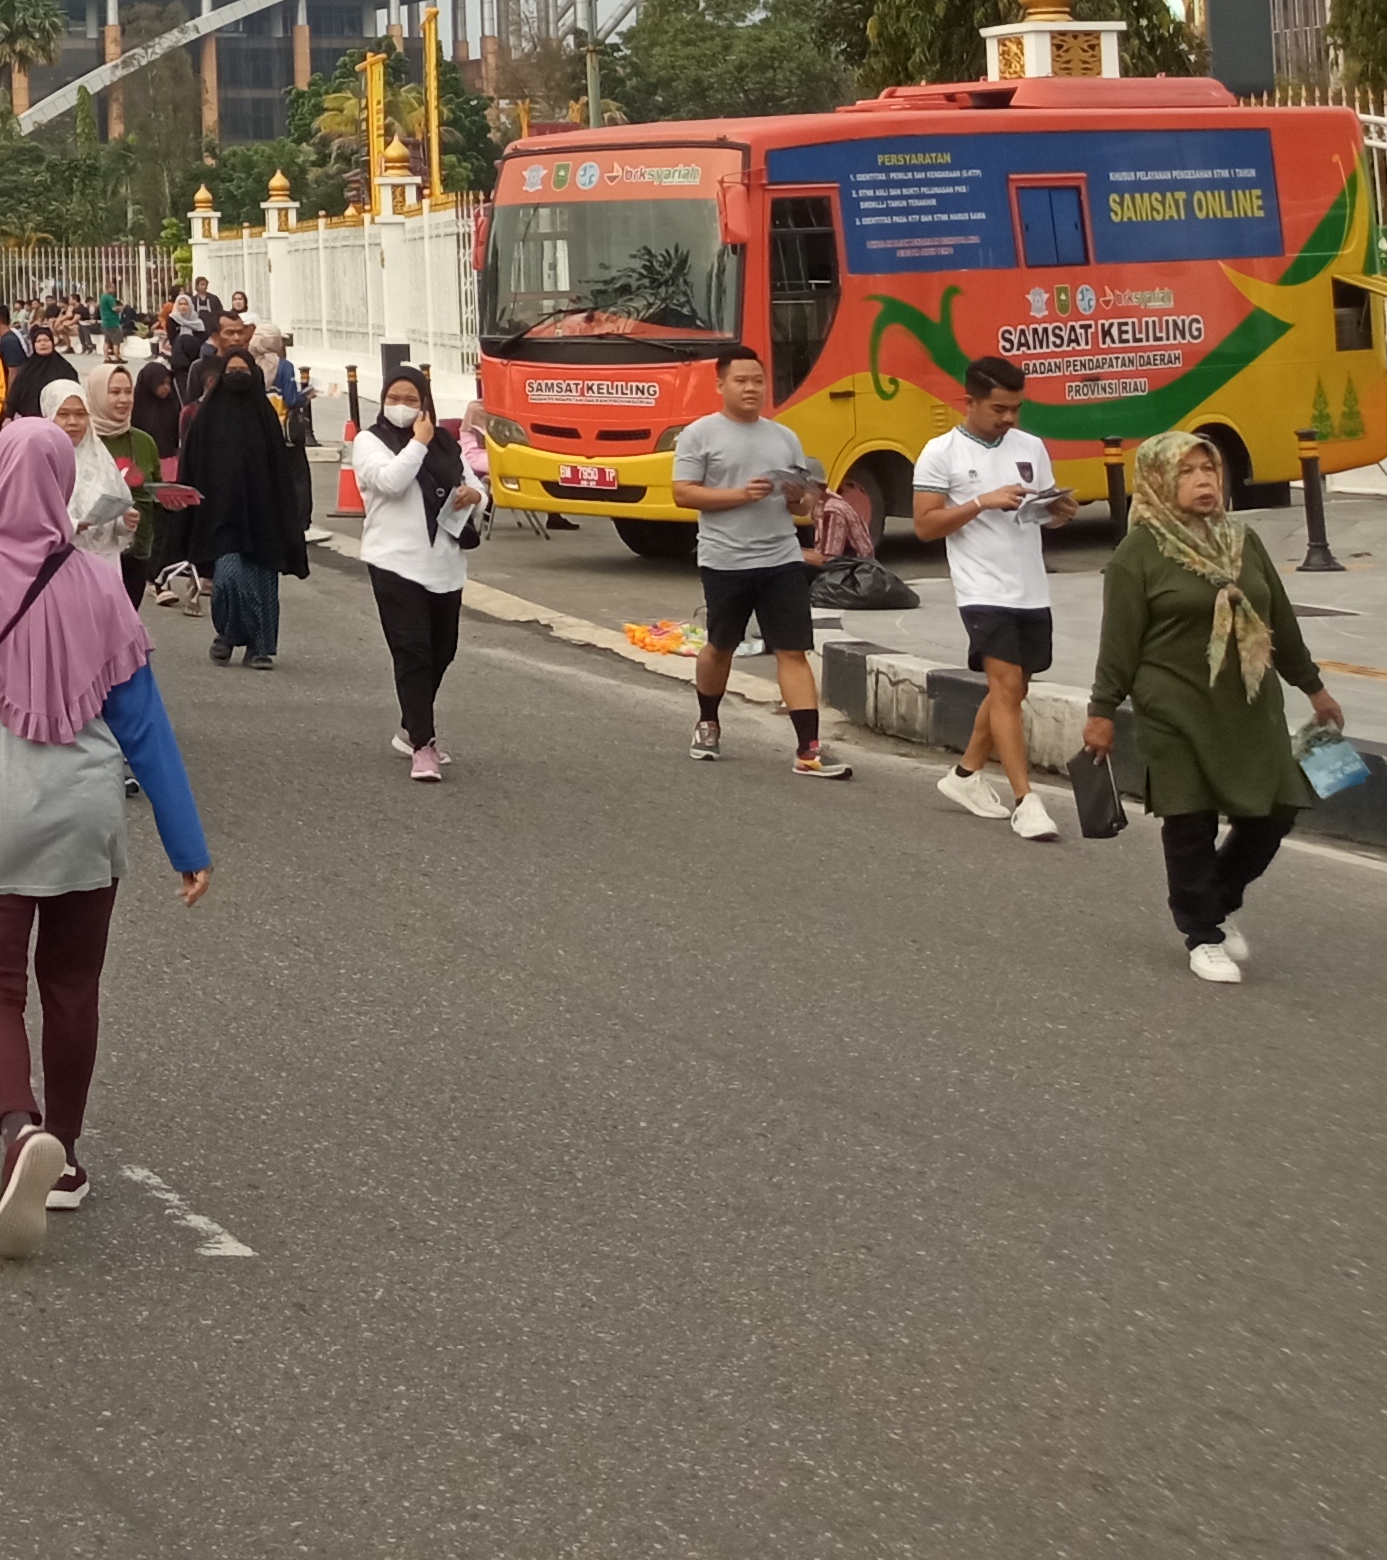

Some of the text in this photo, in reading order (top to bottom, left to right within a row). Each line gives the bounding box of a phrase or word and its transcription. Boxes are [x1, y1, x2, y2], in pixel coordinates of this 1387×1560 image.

[878, 153, 951, 165] PERSYARATAN
[624, 164, 701, 184] brksyariah
[1109, 189, 1265, 223] SAMSAT ONLINE
[1000, 316, 1203, 354] SAMSAT KELILING
[1022, 351, 1182, 377] BADAN PENDAPATAN DAERAH
[526, 380, 658, 397] SAMSAT KELILING
[1067, 379, 1147, 399] PROVINSI RIAU
[560, 465, 571, 478] BM
[605, 468, 615, 481] TP
